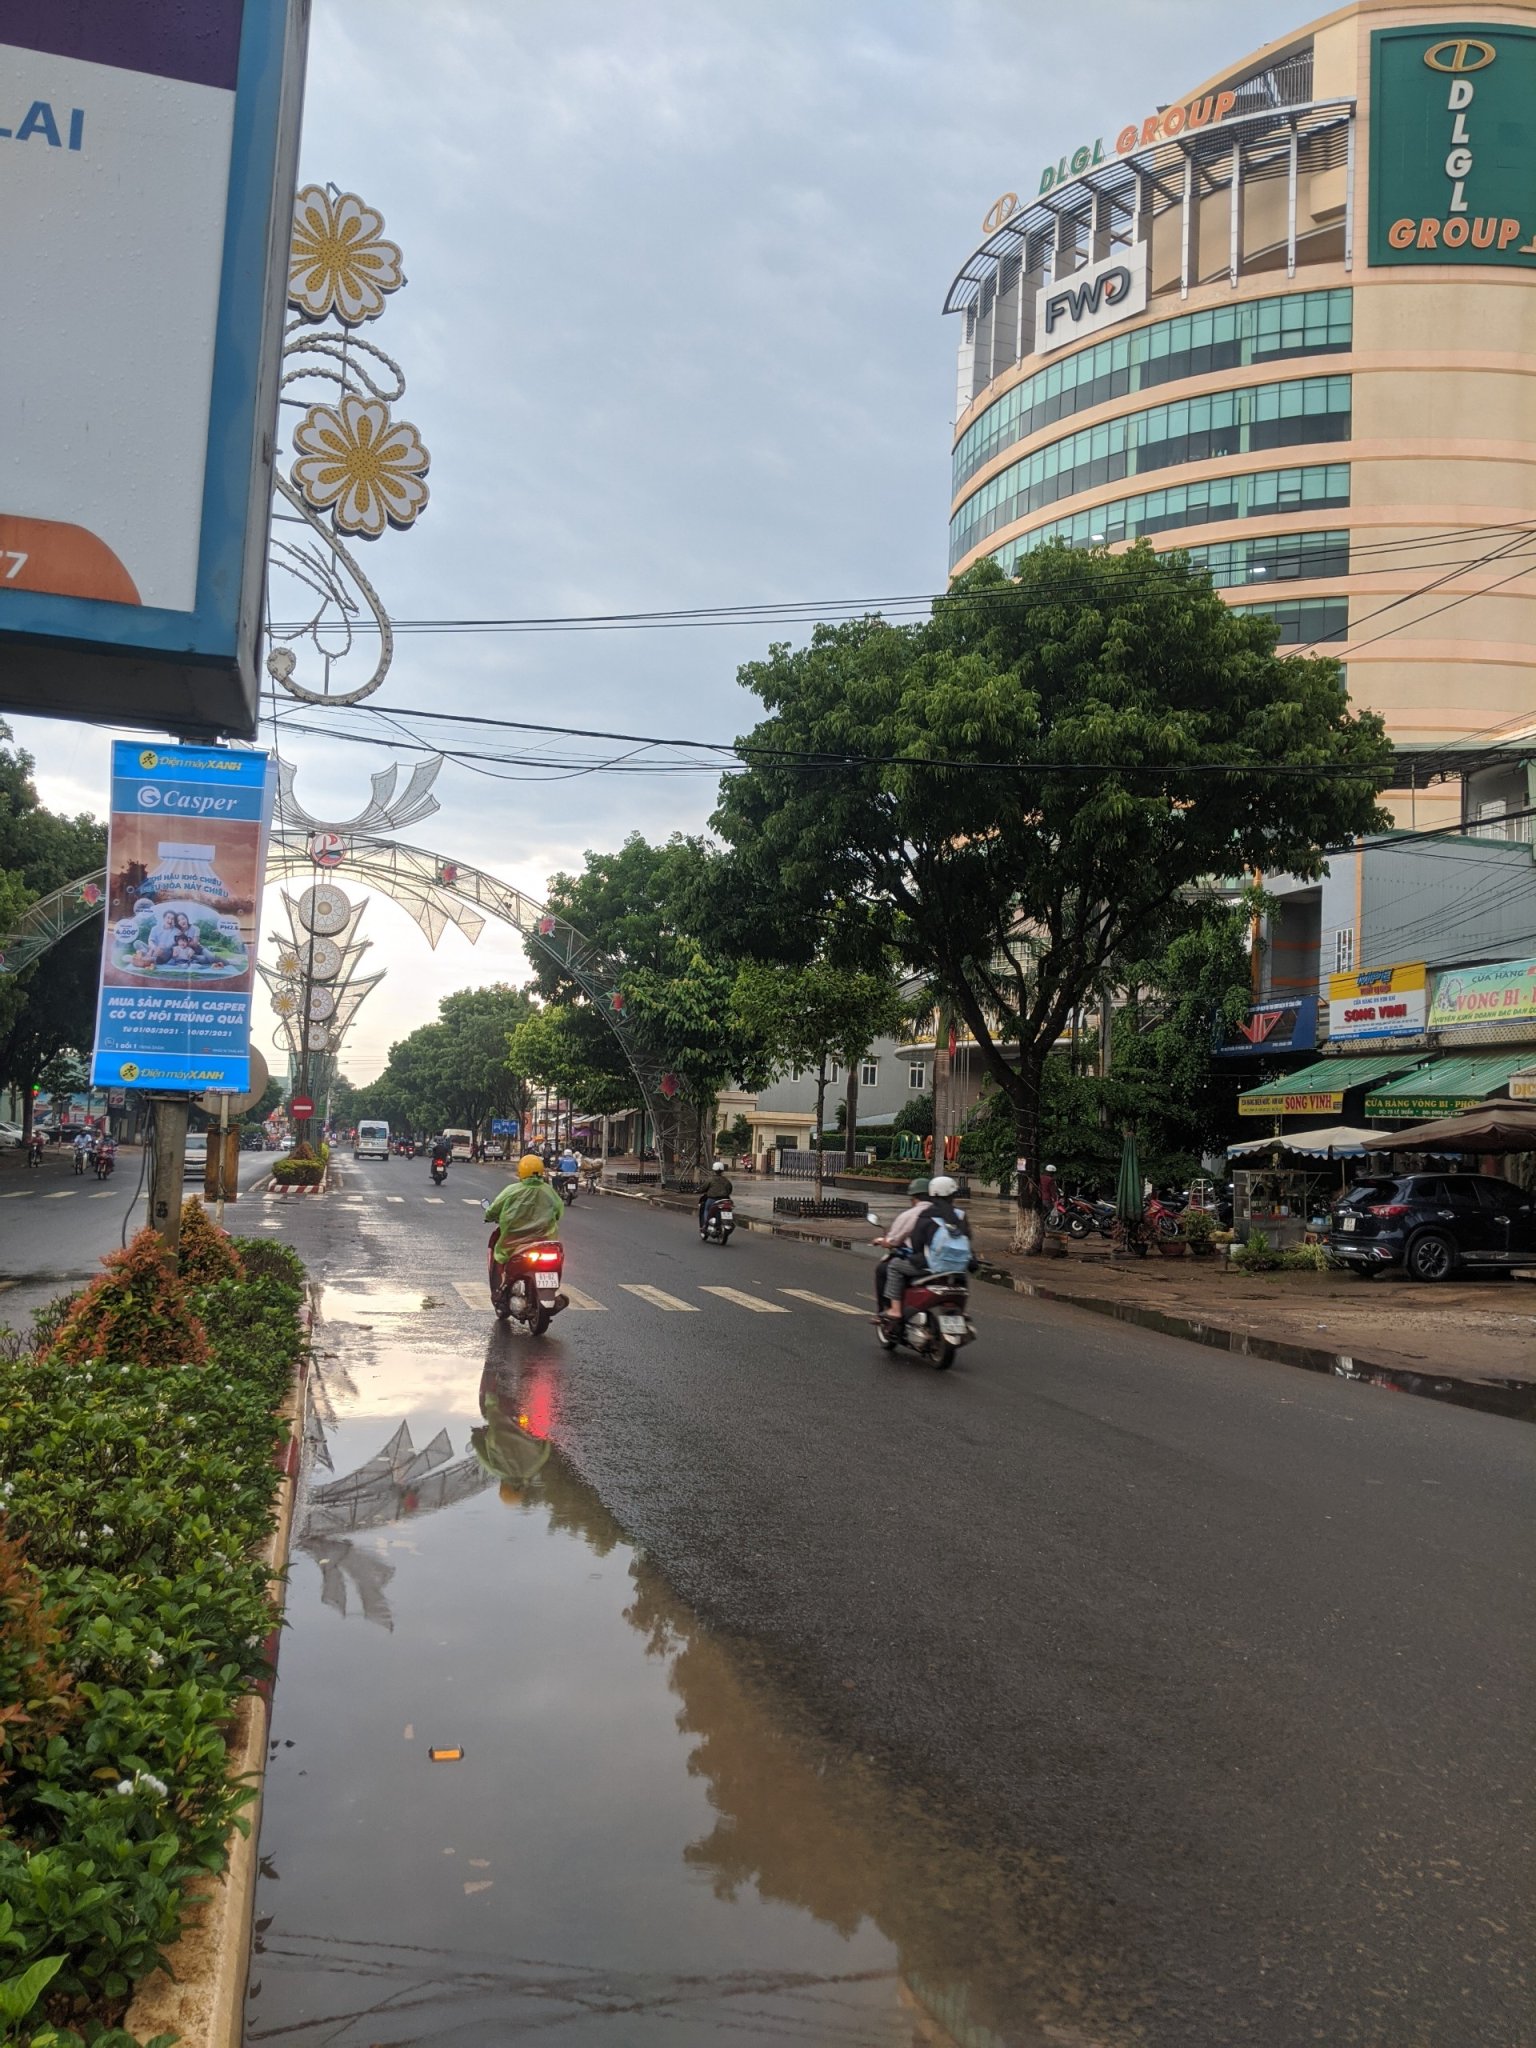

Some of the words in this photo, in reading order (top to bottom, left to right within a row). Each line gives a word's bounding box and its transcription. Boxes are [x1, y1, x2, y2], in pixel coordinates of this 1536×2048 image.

[1038, 137, 1104, 195] DLGL
[1116, 90, 1236, 155] GROUP
[1445, 79, 1474, 212] DLGL
[1388, 216, 1521, 249] GROUP
[1045, 265, 1131, 334] FWD
[163, 789, 238, 814] Casper
[107, 997, 135, 1007] MUA
[137, 995, 161, 1008] SẢN
[202, 1000, 246, 1012] CASPER
[109, 1008, 126, 1020] CÓ
[1343, 1007, 1376, 1022] SONG
[1285, 1095, 1308, 1110] SONG
[1309, 1094, 1332, 1109] VINH
[1439, 1099, 1449, 1108] BI
